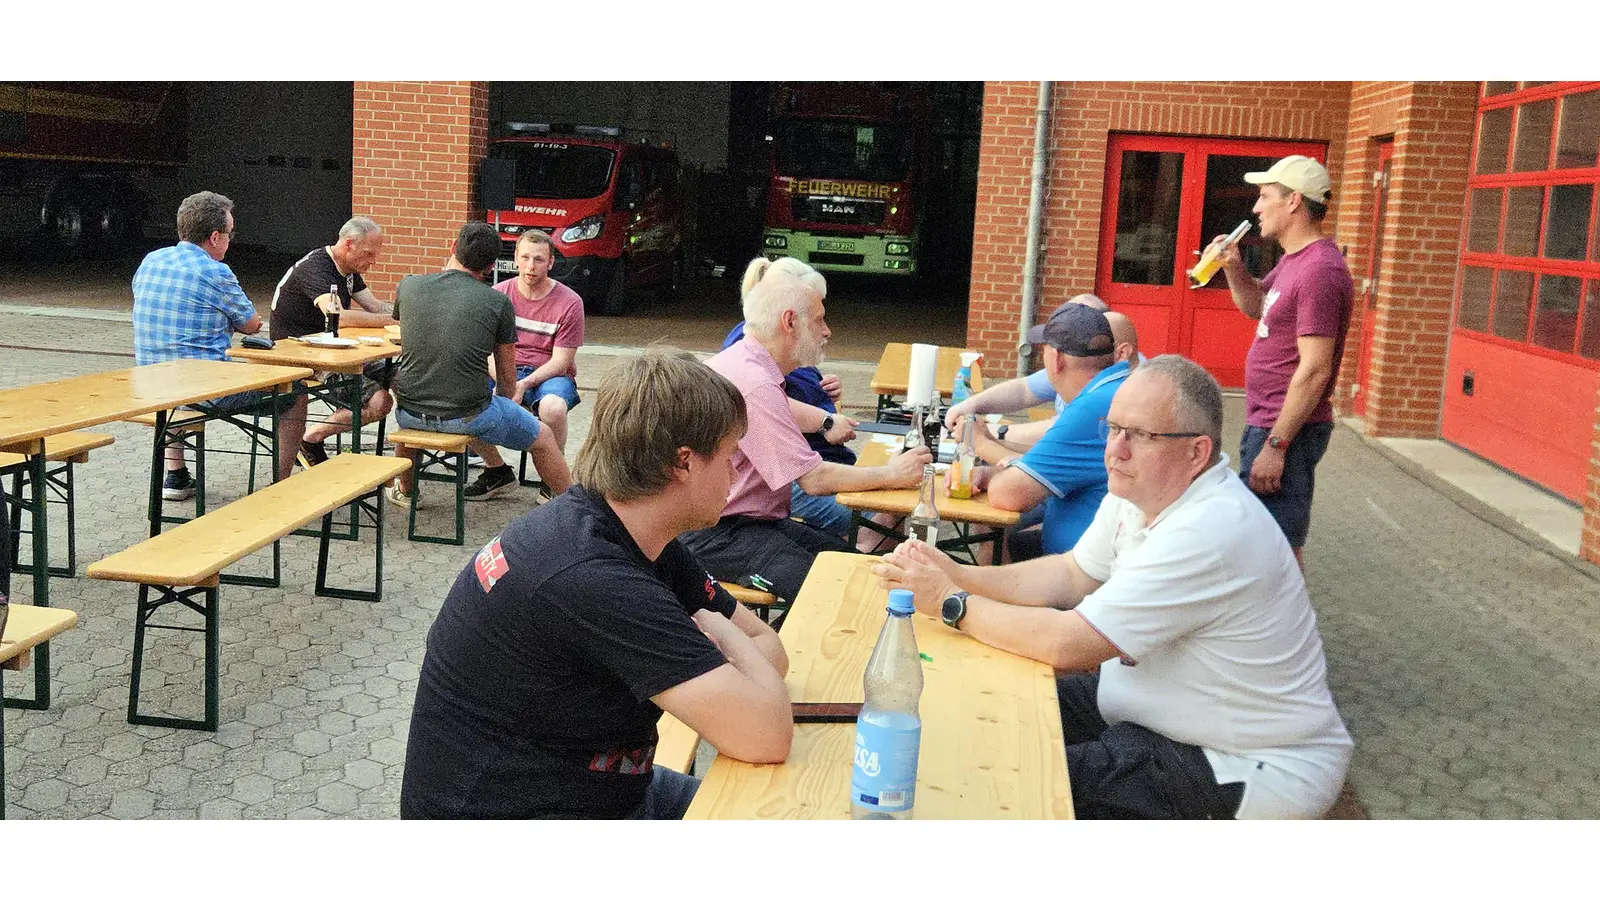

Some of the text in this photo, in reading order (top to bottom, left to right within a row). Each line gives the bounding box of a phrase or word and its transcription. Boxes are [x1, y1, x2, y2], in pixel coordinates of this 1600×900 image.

[788, 179, 891, 199] FEUERWEHR
[514, 205, 568, 217] RWEHR
[822, 203, 855, 214] MAN
